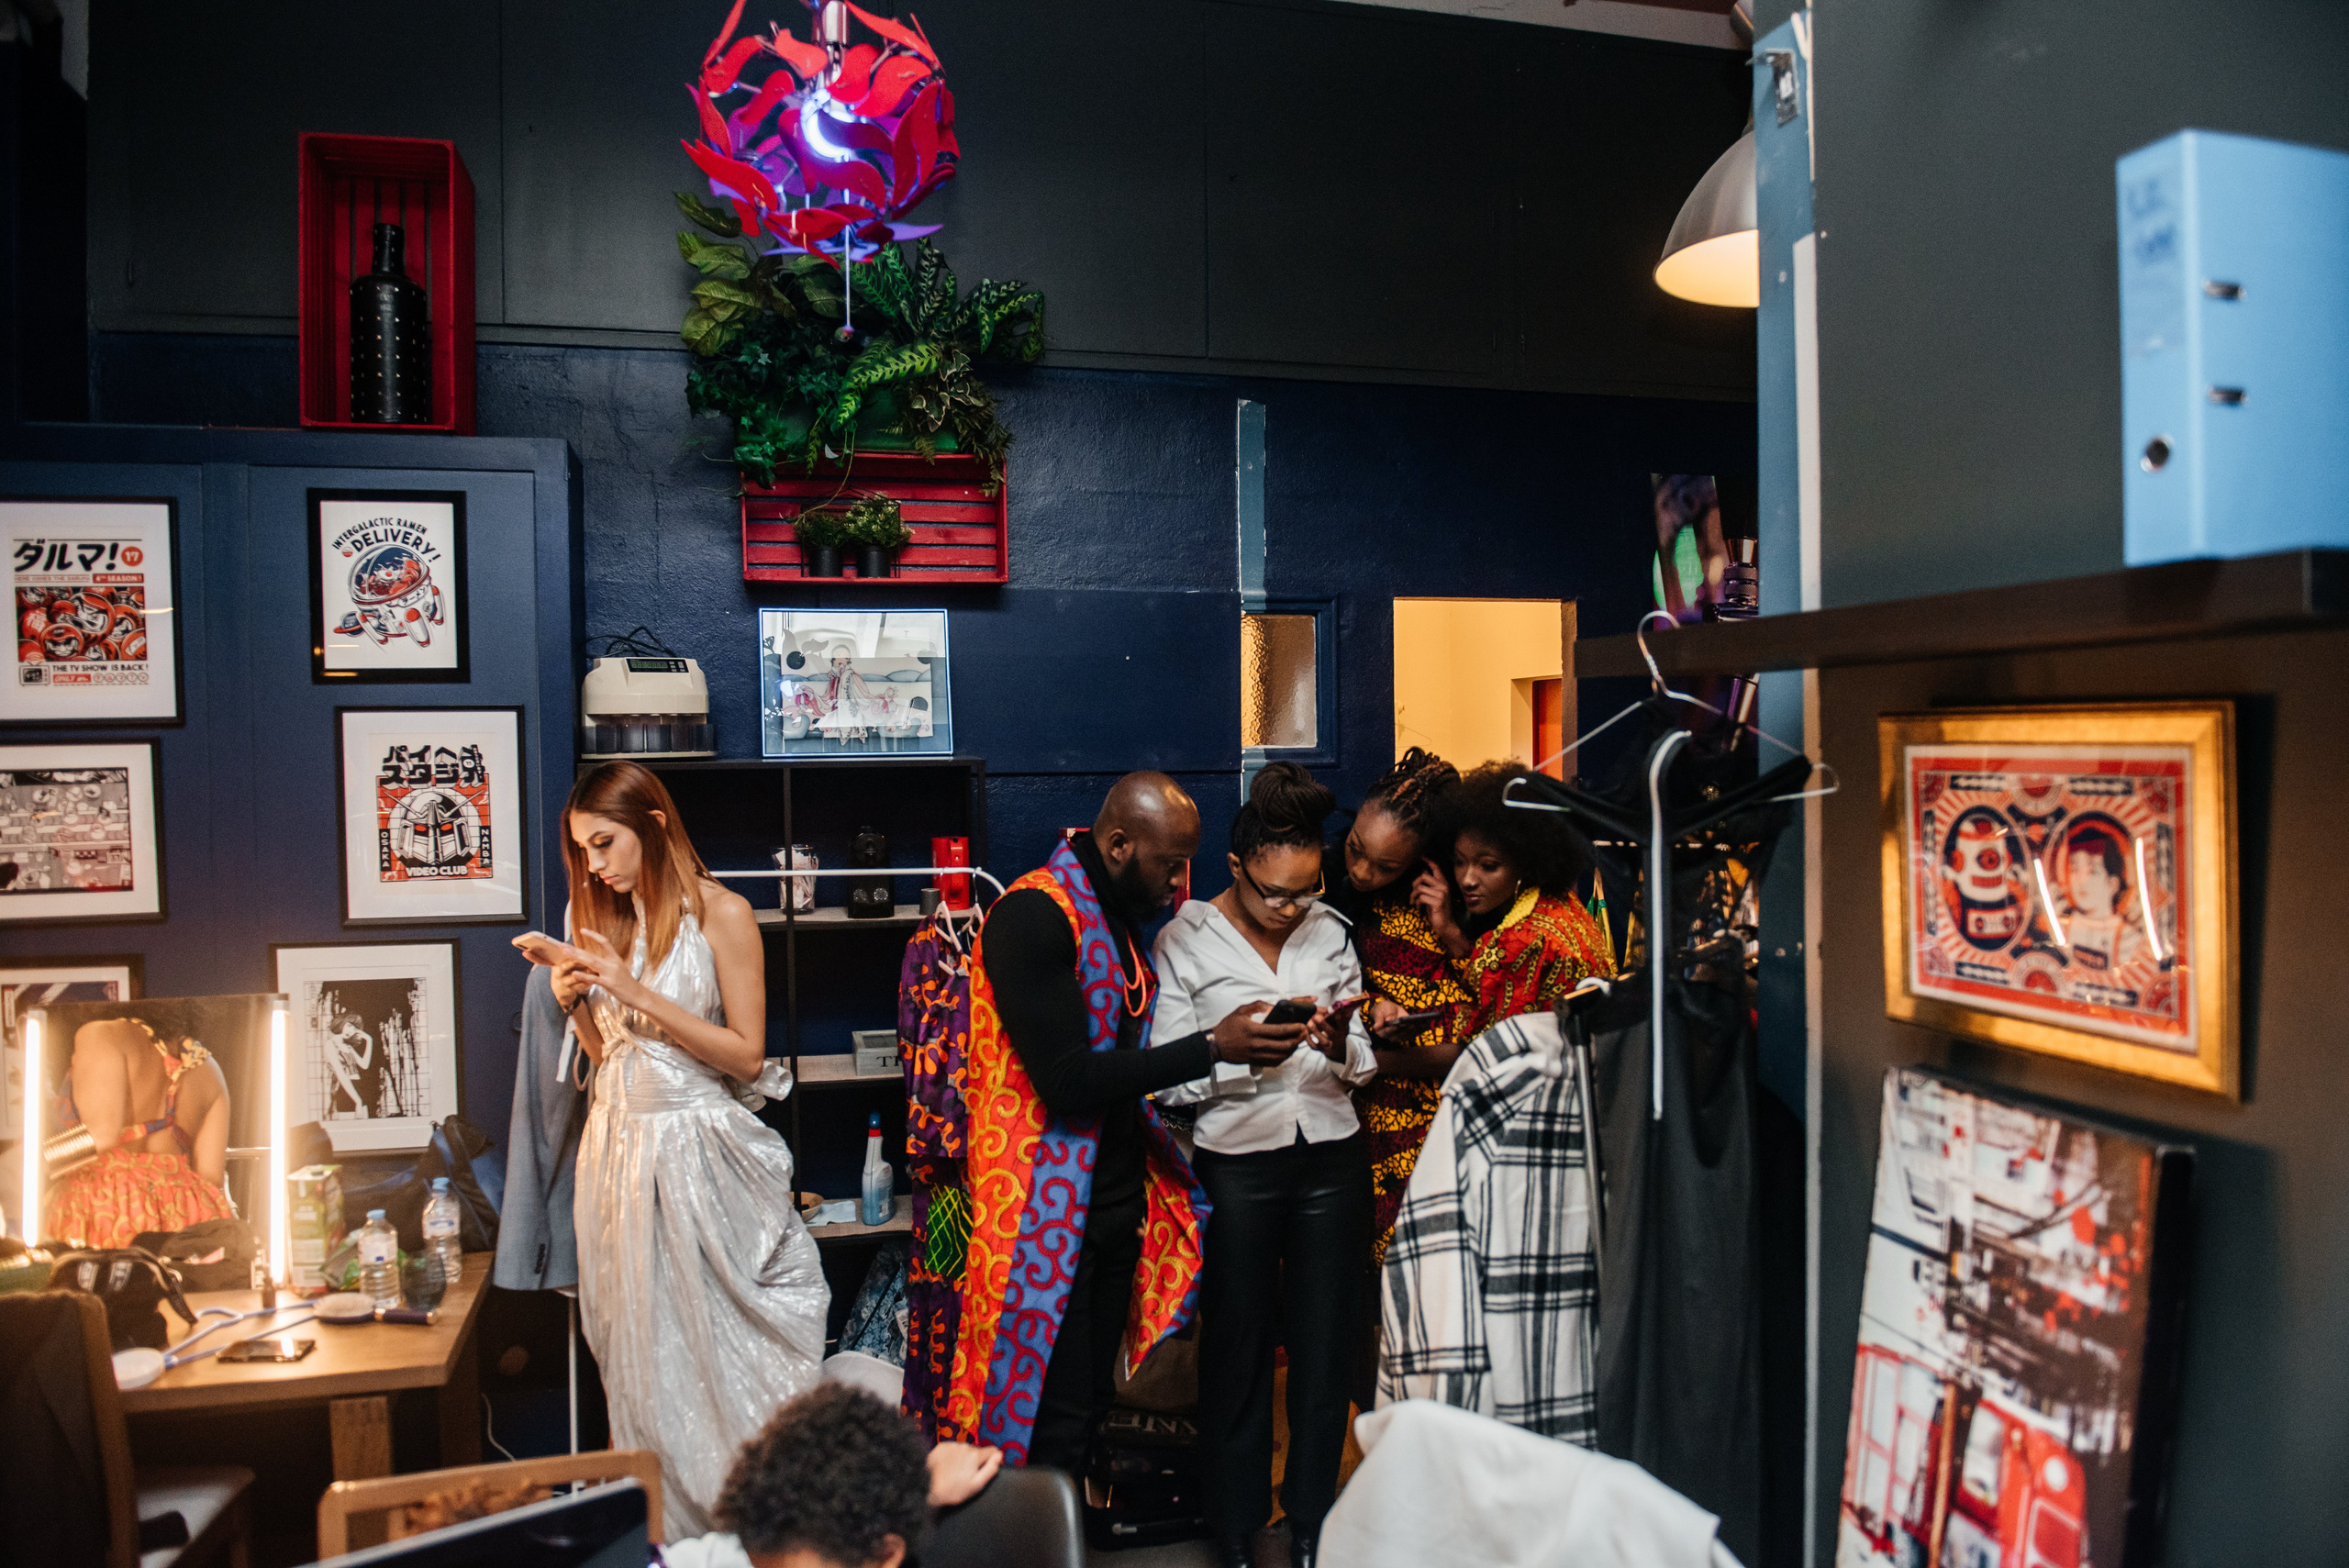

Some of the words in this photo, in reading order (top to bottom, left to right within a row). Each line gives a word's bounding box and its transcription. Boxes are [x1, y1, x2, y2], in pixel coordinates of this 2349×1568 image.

[331, 517, 394, 550] INTERGALACTIC
[396, 518, 428, 535] RAMEN
[351, 528, 441, 562] DELIVERY!
[125, 551, 140, 562] 17
[380, 831, 391, 868] OSAKA
[480, 828, 491, 864] NAMBA
[406, 867, 439, 877] VIDEO
[439, 865, 469, 876] CLUB
